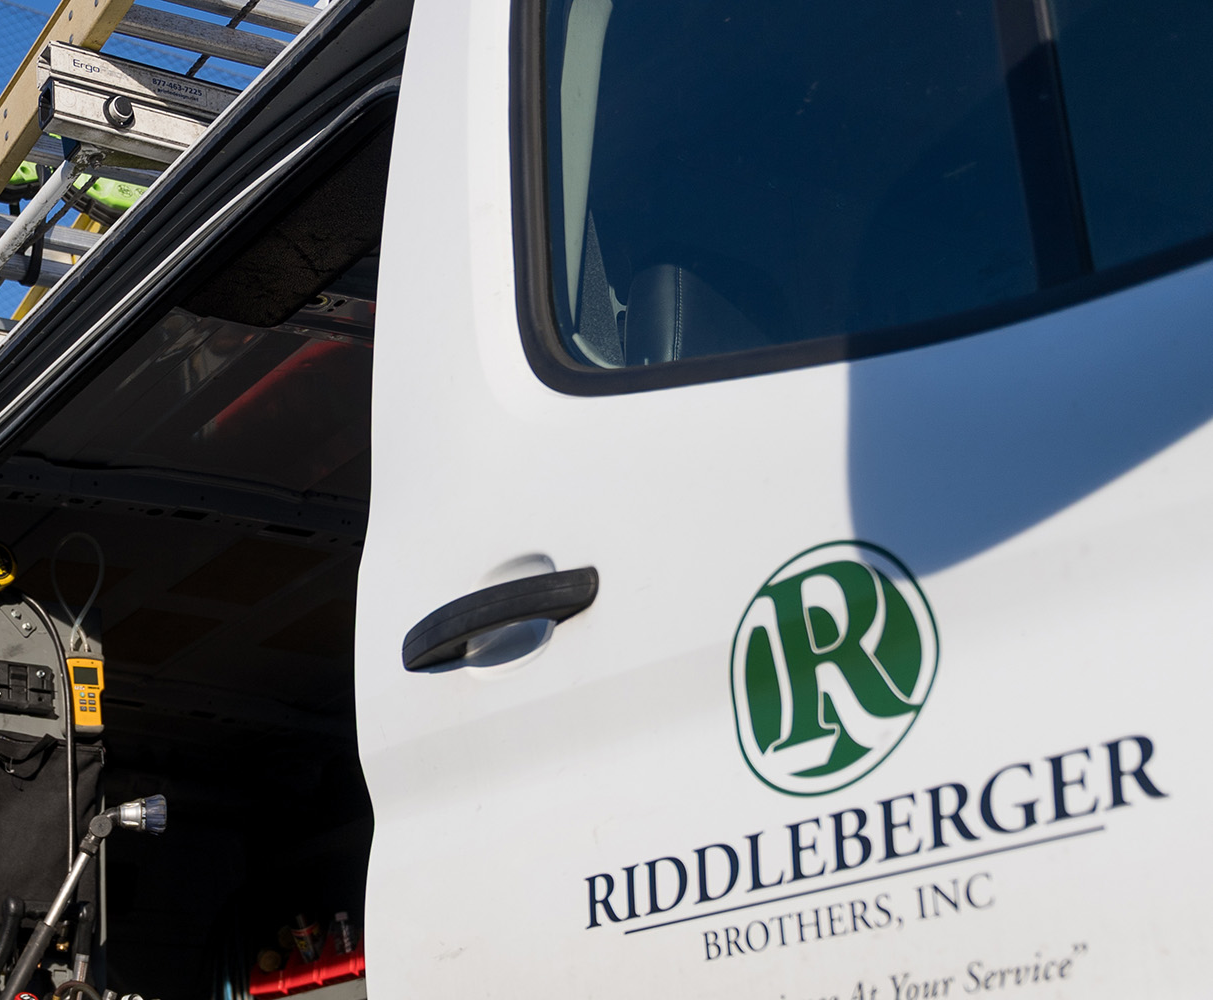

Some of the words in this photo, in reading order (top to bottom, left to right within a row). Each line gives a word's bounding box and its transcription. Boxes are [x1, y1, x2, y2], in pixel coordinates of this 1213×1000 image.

[72, 58, 100, 73] Ergo
[584, 733, 1170, 930] RIDDLEBERGER
[702, 893, 904, 962] BROTHERS,
[914, 872, 996, 919] INC
